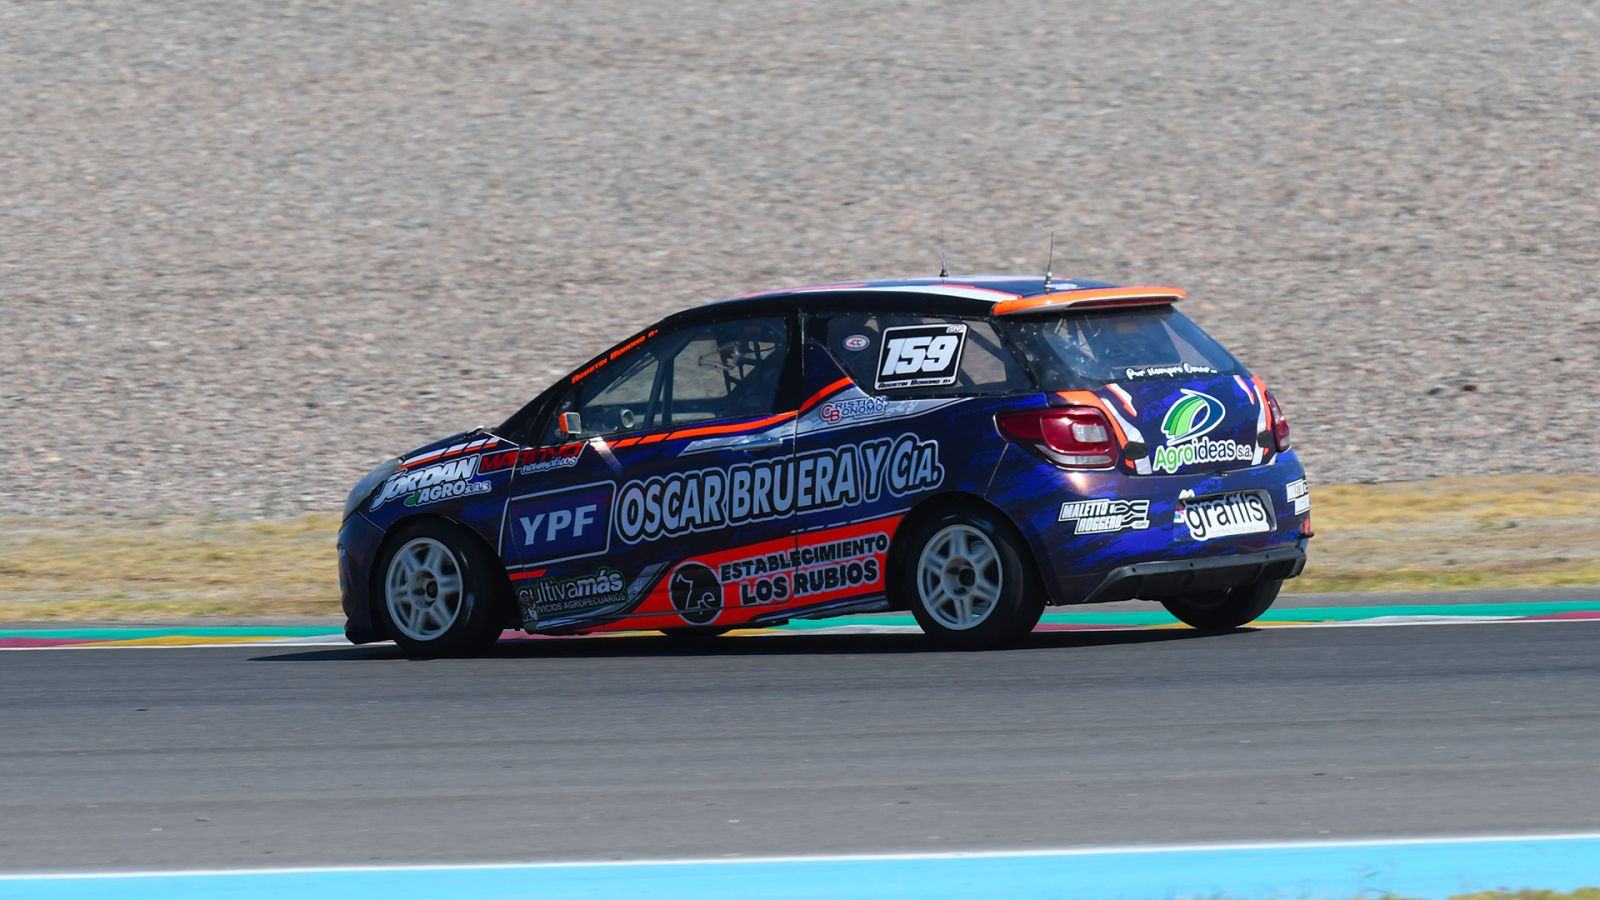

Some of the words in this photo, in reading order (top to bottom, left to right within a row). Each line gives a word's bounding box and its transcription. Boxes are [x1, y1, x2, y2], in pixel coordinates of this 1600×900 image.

[881, 336, 958, 376] 159
[1155, 436, 1235, 472] Agroideas
[370, 456, 478, 509] JORDAN
[417, 480, 466, 504] AGRO
[621, 473, 722, 537] OSCAR
[731, 452, 857, 516] BRUERA
[863, 445, 889, 497] Y
[891, 439, 939, 490] CIA.
[519, 503, 598, 546] YPF
[1061, 501, 1109, 519] MALETTO
[720, 535, 888, 582] ESTABLECIMIENTO
[741, 576, 788, 605] LOS
[795, 559, 878, 595] RUBIOS
